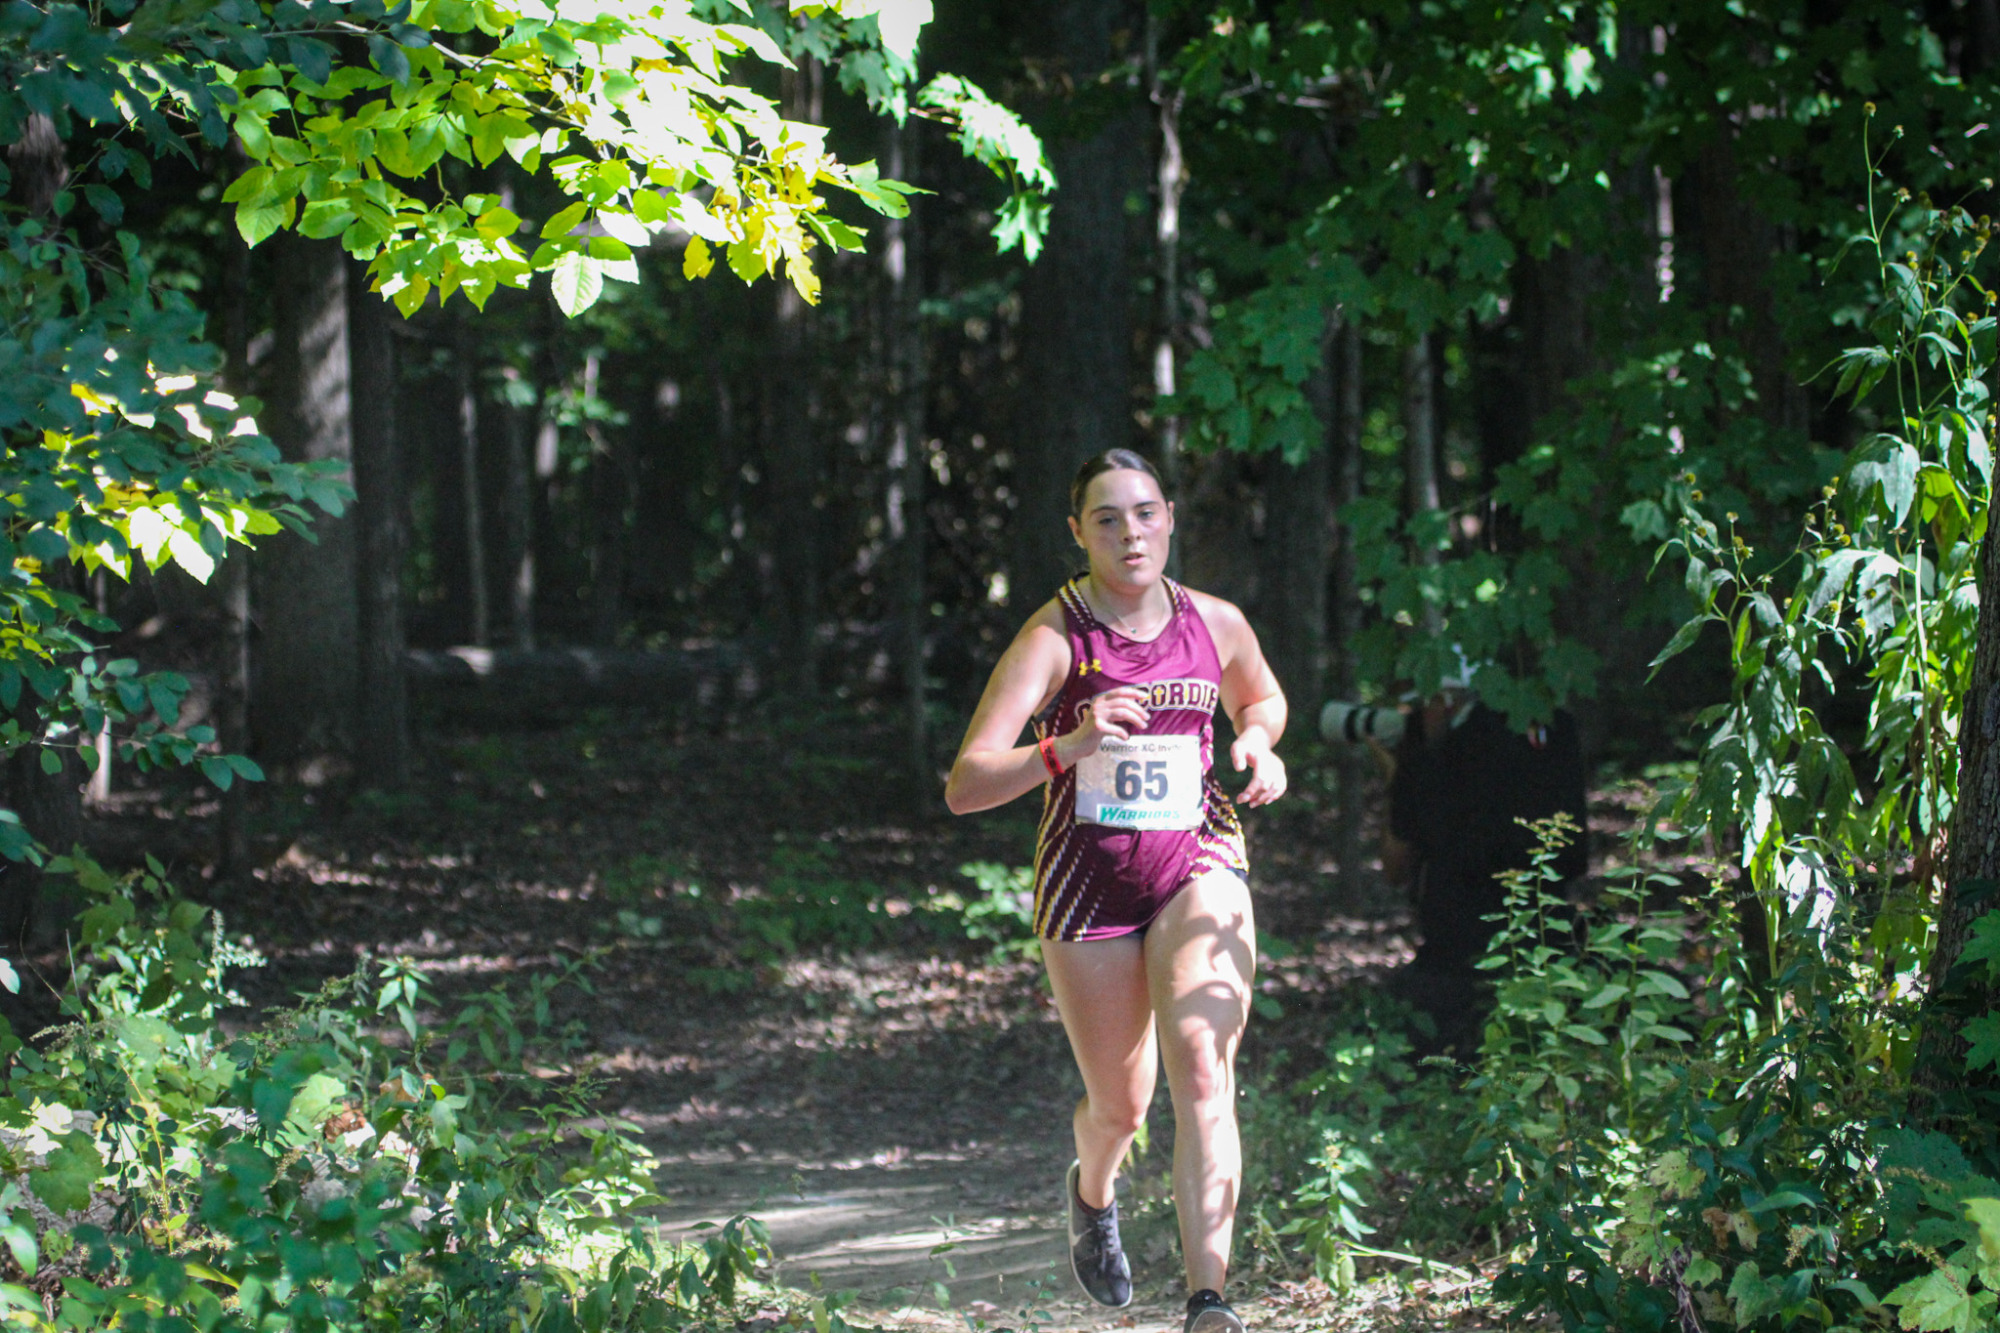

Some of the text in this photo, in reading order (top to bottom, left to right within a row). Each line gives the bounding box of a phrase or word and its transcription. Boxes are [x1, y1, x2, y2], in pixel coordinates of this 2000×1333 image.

[1075, 678, 1218, 724] CCORDI
[1100, 743, 1182, 753] Warrior XC Inv
[1115, 760, 1168, 801] 65
[1100, 806, 1181, 822] WARRIORS
